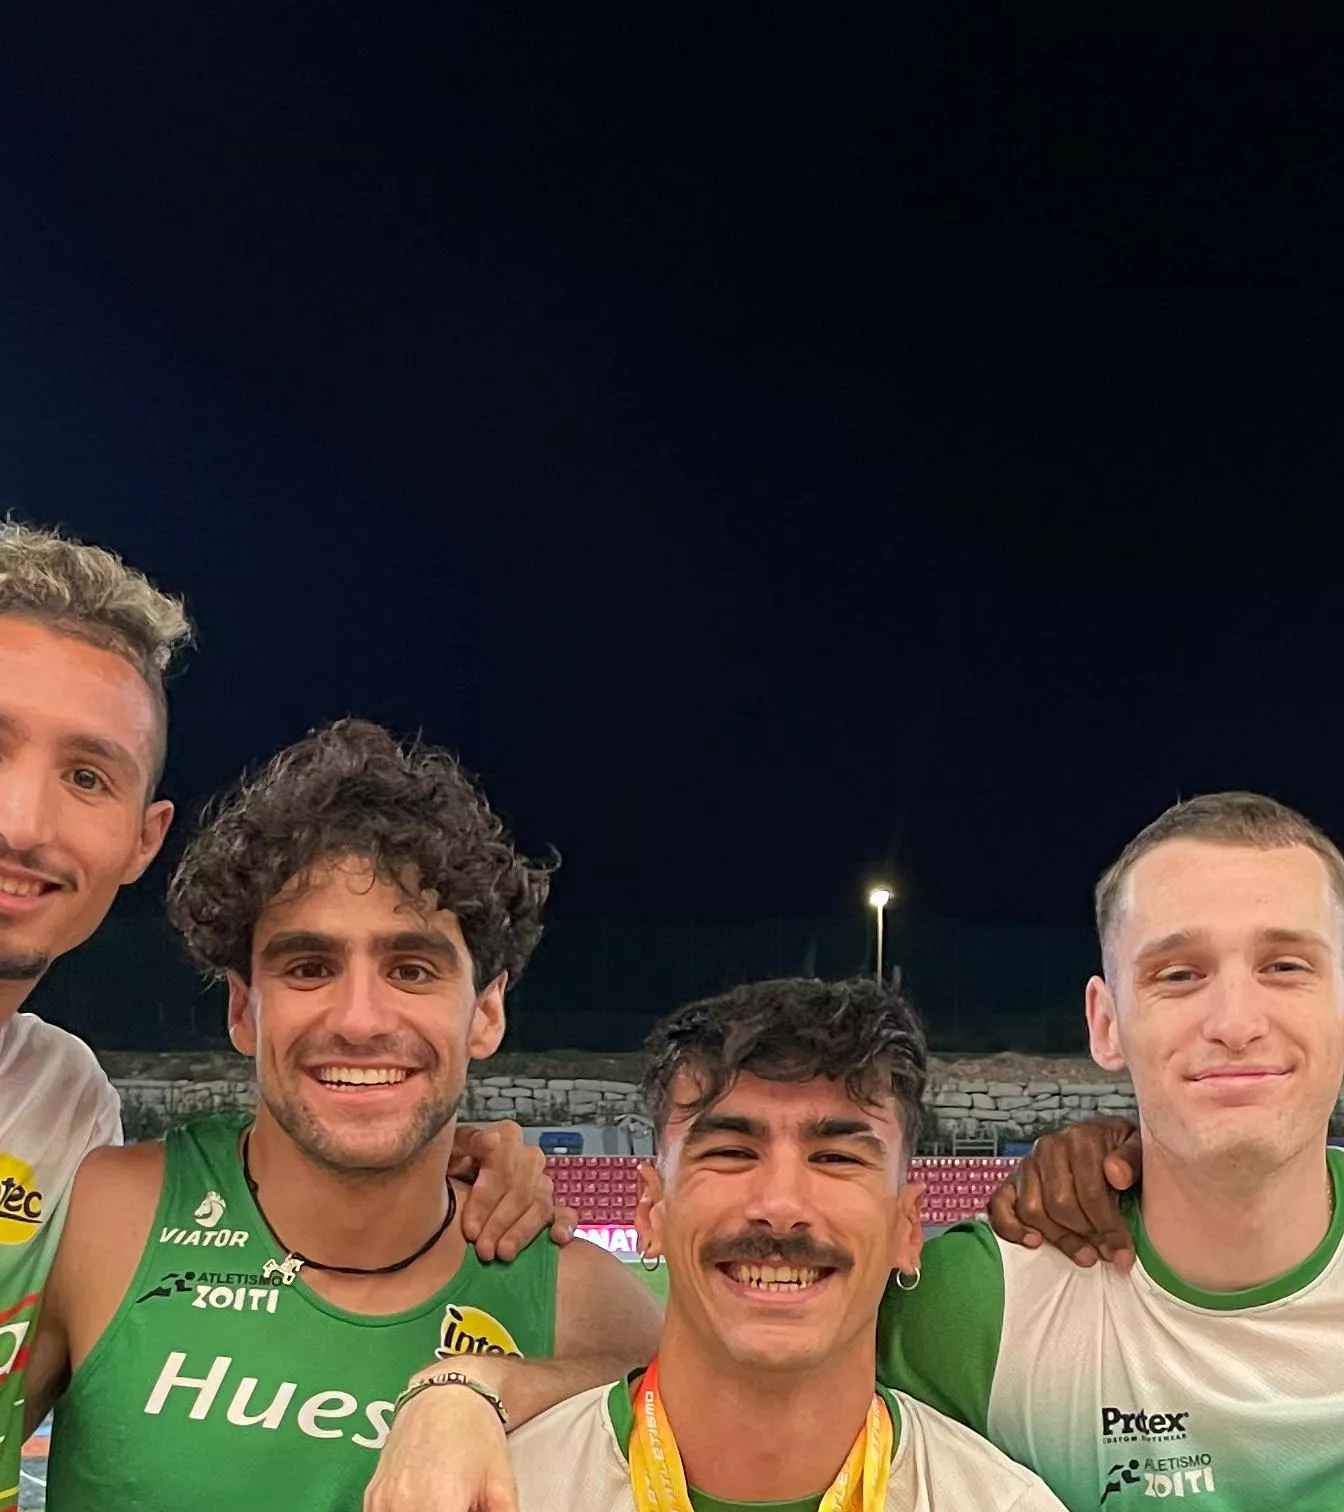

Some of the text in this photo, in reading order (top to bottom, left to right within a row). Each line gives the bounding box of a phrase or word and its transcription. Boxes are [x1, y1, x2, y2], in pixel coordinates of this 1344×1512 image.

[159, 1227, 249, 1248] VIATOR
[191, 1286, 279, 1314] ZOITI
[144, 1351, 397, 1449] Hues
